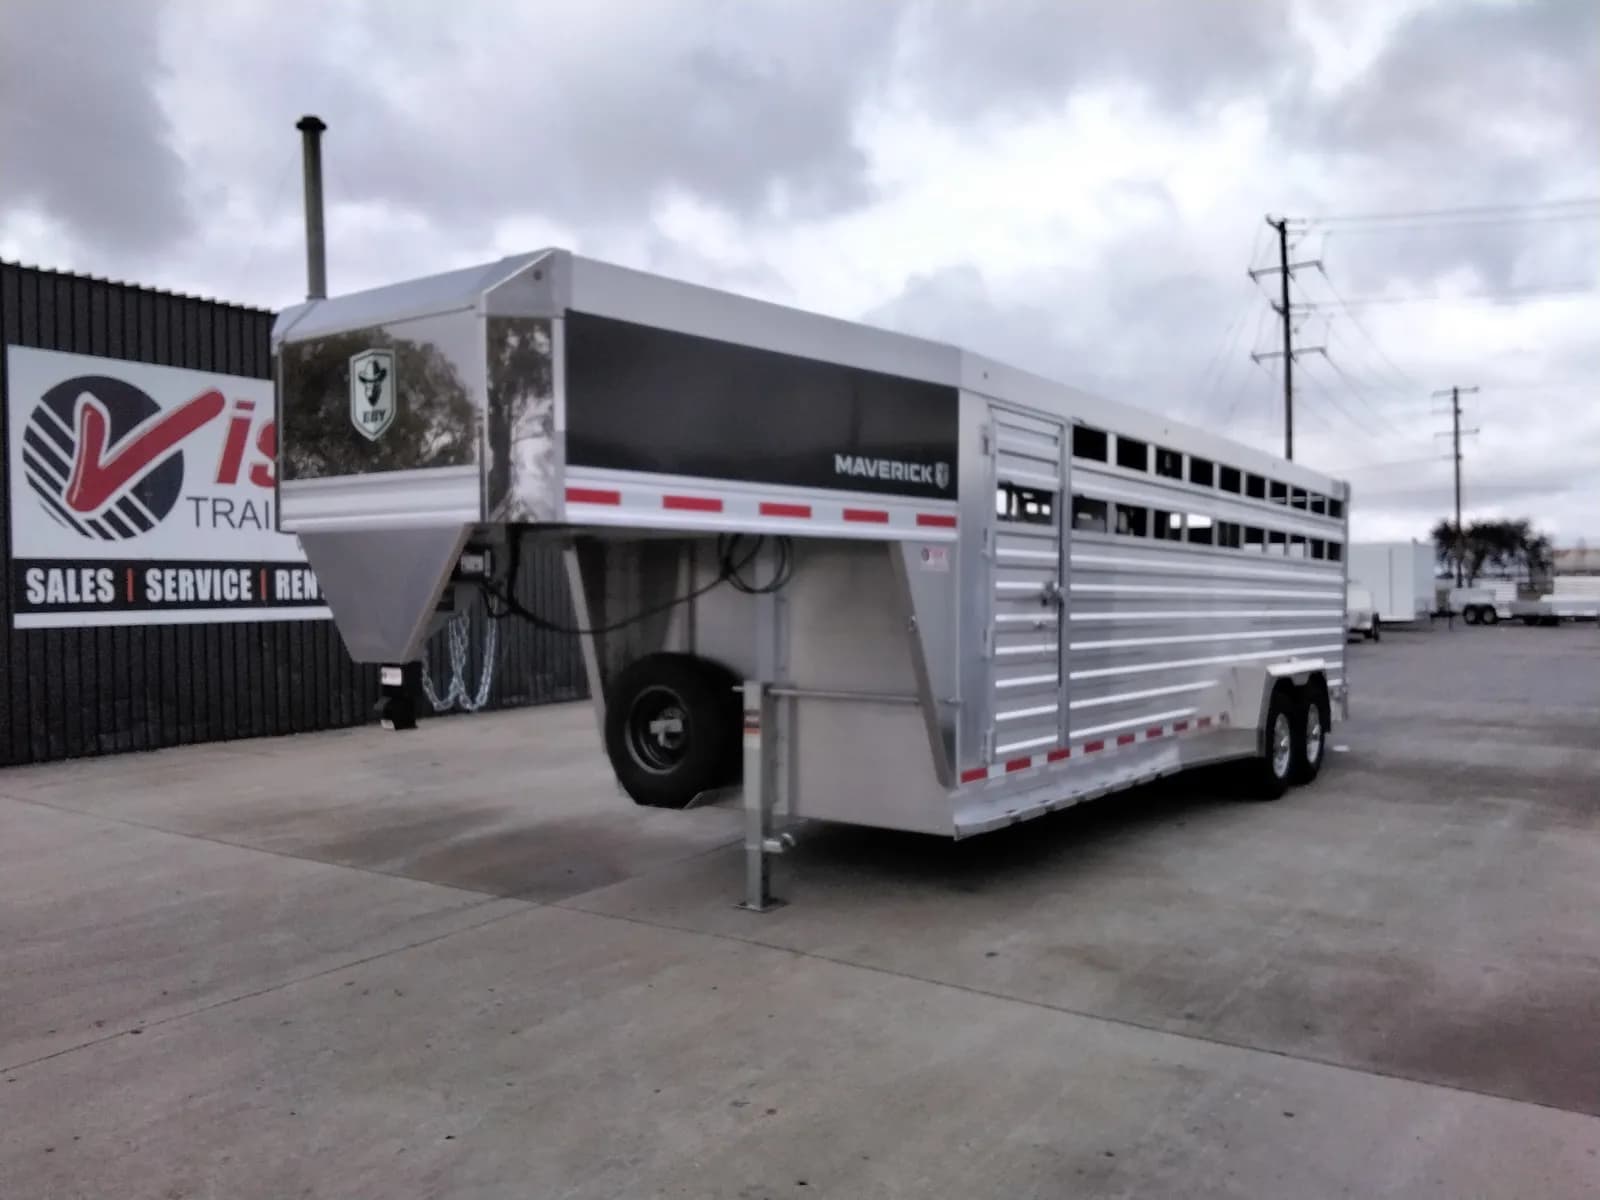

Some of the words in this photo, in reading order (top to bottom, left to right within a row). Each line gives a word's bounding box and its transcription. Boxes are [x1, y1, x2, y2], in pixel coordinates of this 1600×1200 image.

[834, 454, 932, 484] MAVERICK
[186, 496, 270, 530] TRAI
[26, 567, 115, 604] SALES
[145, 568, 252, 602] SERVICE
[275, 569, 325, 600] REN
